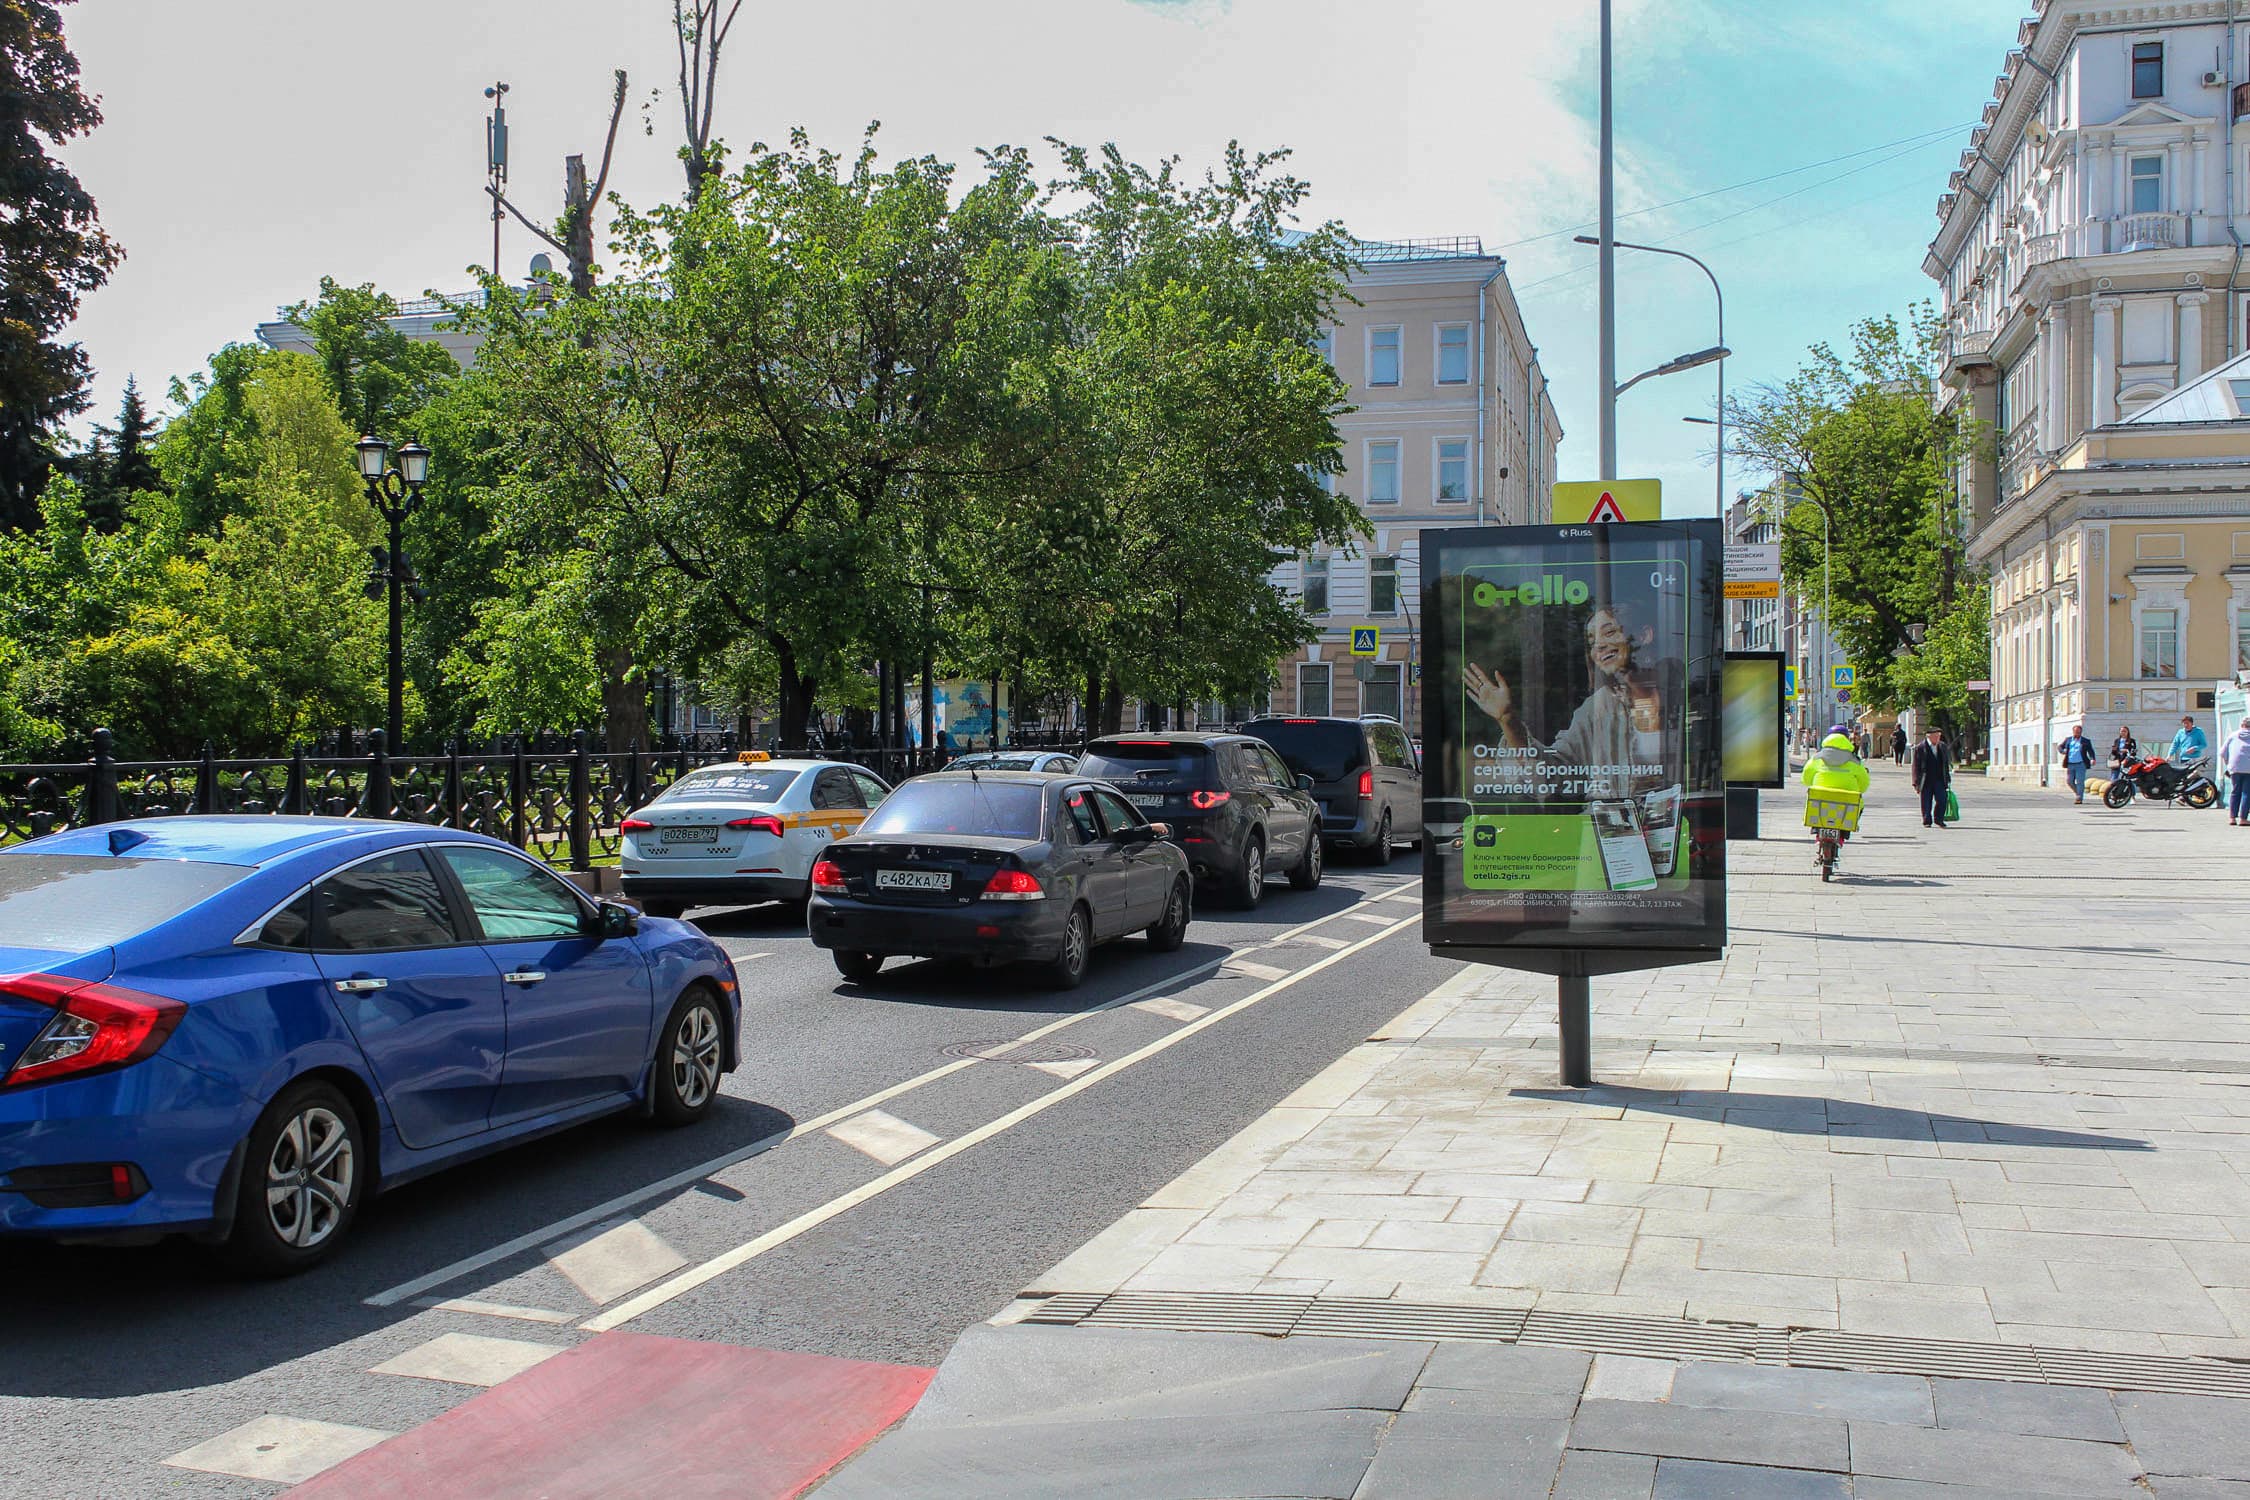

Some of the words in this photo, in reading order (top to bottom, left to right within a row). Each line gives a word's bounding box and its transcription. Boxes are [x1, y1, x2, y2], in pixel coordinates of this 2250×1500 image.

[1569, 529, 1593, 537] Russ
[1650, 572, 1677, 588] 0+
[1473, 574, 1589, 608] otello
[1473, 744, 1538, 758] Отелло
[1473, 763, 1533, 779] сервис
[1535, 761, 1664, 779] бронирования
[1473, 780, 1534, 795] отелей
[1538, 783, 1558, 795] от
[1562, 780, 1612, 795] 2ГИС
[1473, 854, 1496, 862] Ключ
[1502, 855, 1531, 864] твоему
[1532, 853, 1593, 864] бронированию
[1480, 864, 1533, 872] путешествиях
[1547, 863, 1576, 871] России
[1473, 872, 1531, 881] otello.2gis.ru
